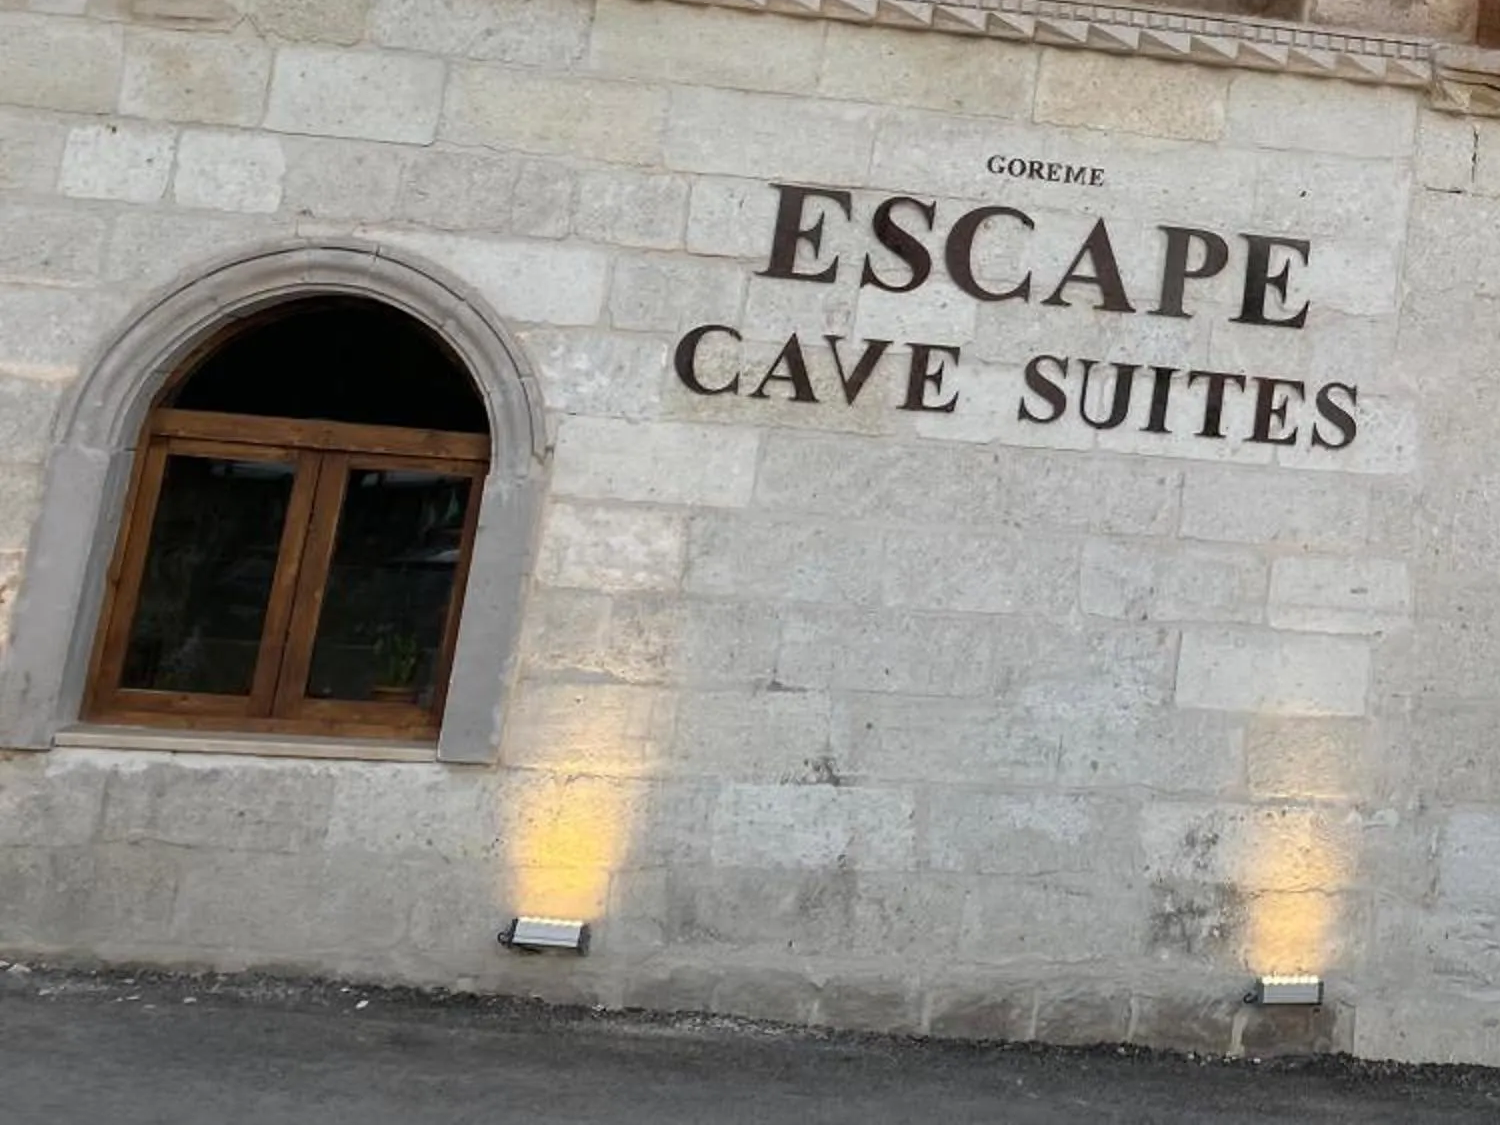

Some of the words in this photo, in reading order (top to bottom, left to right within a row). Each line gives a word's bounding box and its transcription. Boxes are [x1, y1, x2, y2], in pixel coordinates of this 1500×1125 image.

[987, 154, 1106, 187] GOREME
[754, 183, 1311, 329] ESCAPE
[674, 324, 961, 414] CAVE
[1017, 354, 1359, 450] SUITES
